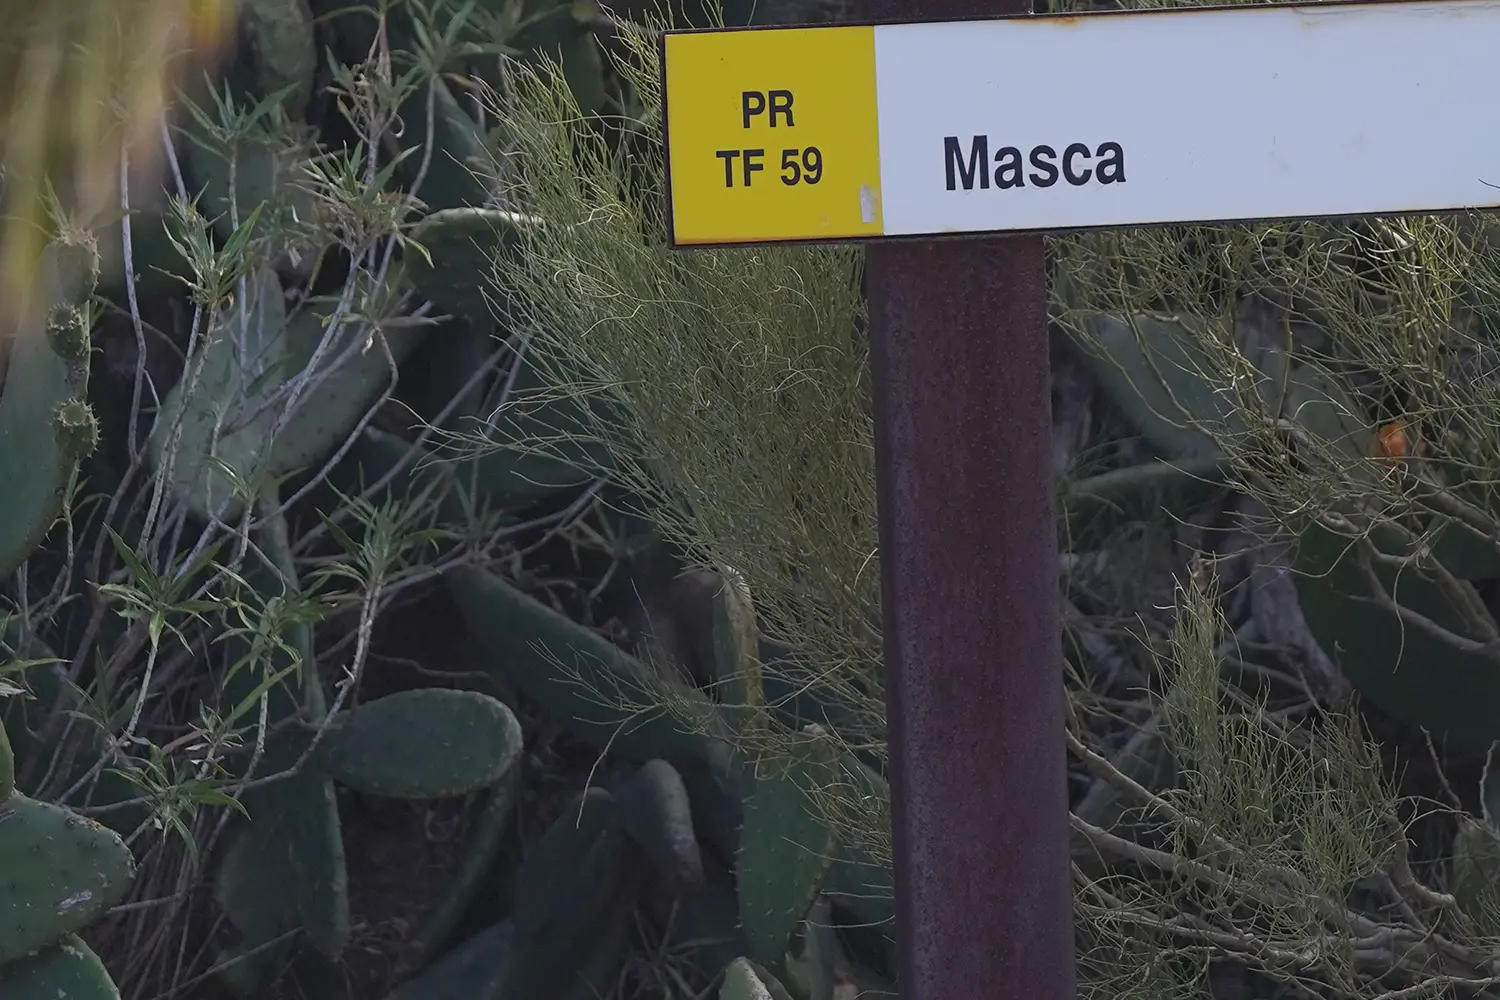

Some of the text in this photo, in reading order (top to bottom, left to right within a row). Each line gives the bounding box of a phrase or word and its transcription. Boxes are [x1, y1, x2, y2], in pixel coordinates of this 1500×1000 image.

[741, 89, 795, 129] PR
[716, 146, 823, 188] TF 59
[943, 134, 1127, 191] Masca
